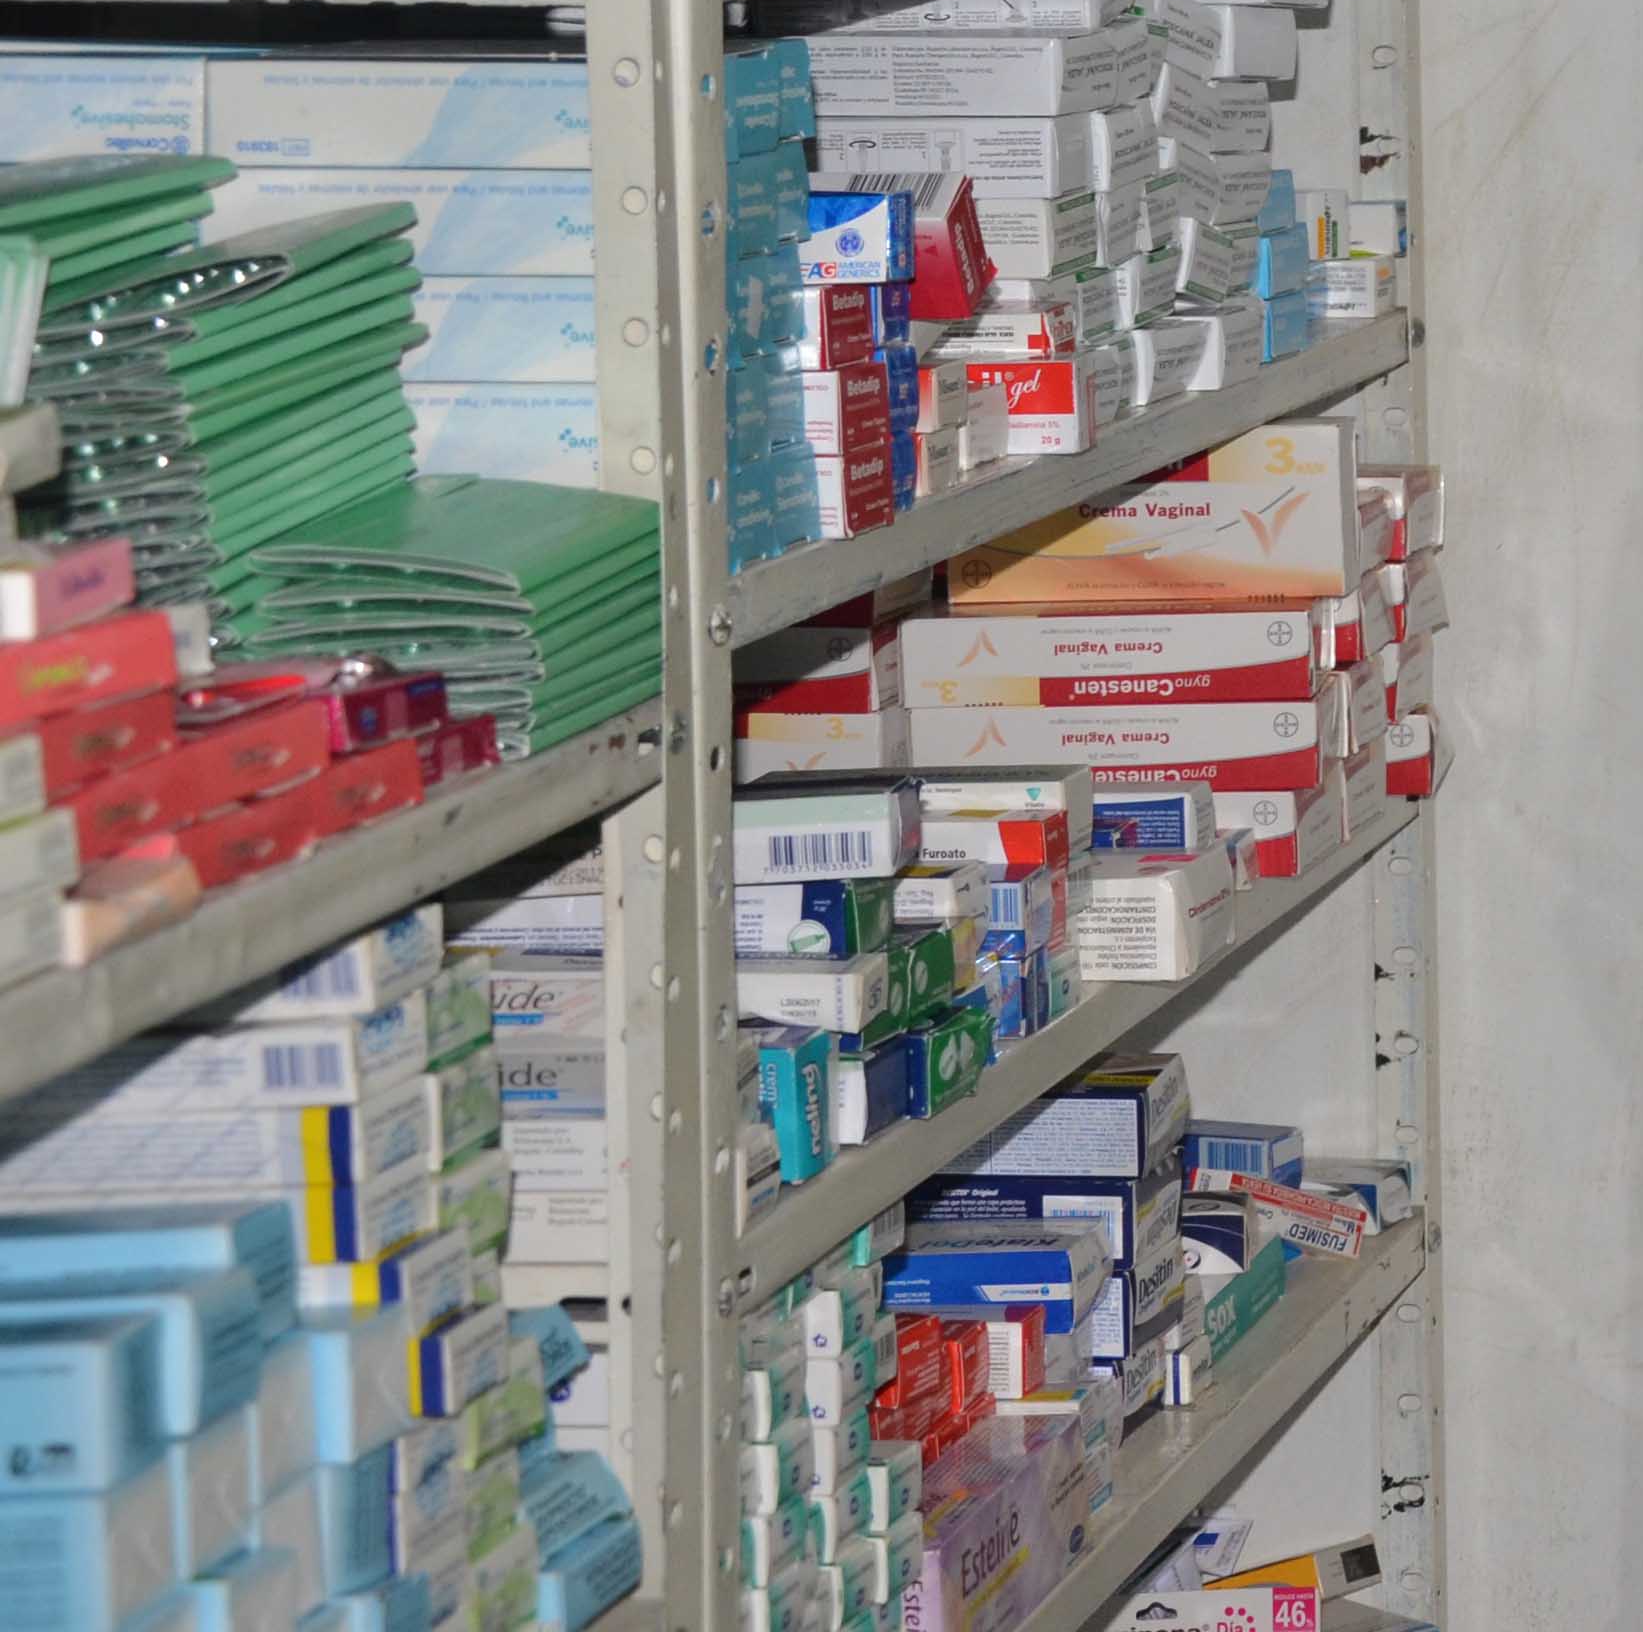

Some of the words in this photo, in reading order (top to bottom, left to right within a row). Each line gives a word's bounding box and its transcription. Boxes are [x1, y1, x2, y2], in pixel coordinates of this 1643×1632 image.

[833, 291, 865, 311] Betadip
[847, 376, 881, 397] Betadip
[1008, 369, 1040, 408] gel
[1264, 436, 1296, 475] 3
[850, 458, 884, 481] Betadip
[1079, 503, 1137, 518] Crema
[1145, 502, 1211, 520] Vaginal
[1054, 641, 1109, 657] Vaginal
[1117, 641, 1163, 654] Crema
[1074, 674, 1211, 696] gynoCanesten
[1062, 732, 1116, 746] Vaginal
[1121, 732, 1170, 745] Crema
[922, 848, 966, 860] Furoato
[1288, 1221, 1348, 1252] FUSIMED
[1137, 1257, 1174, 1304] Desitin
